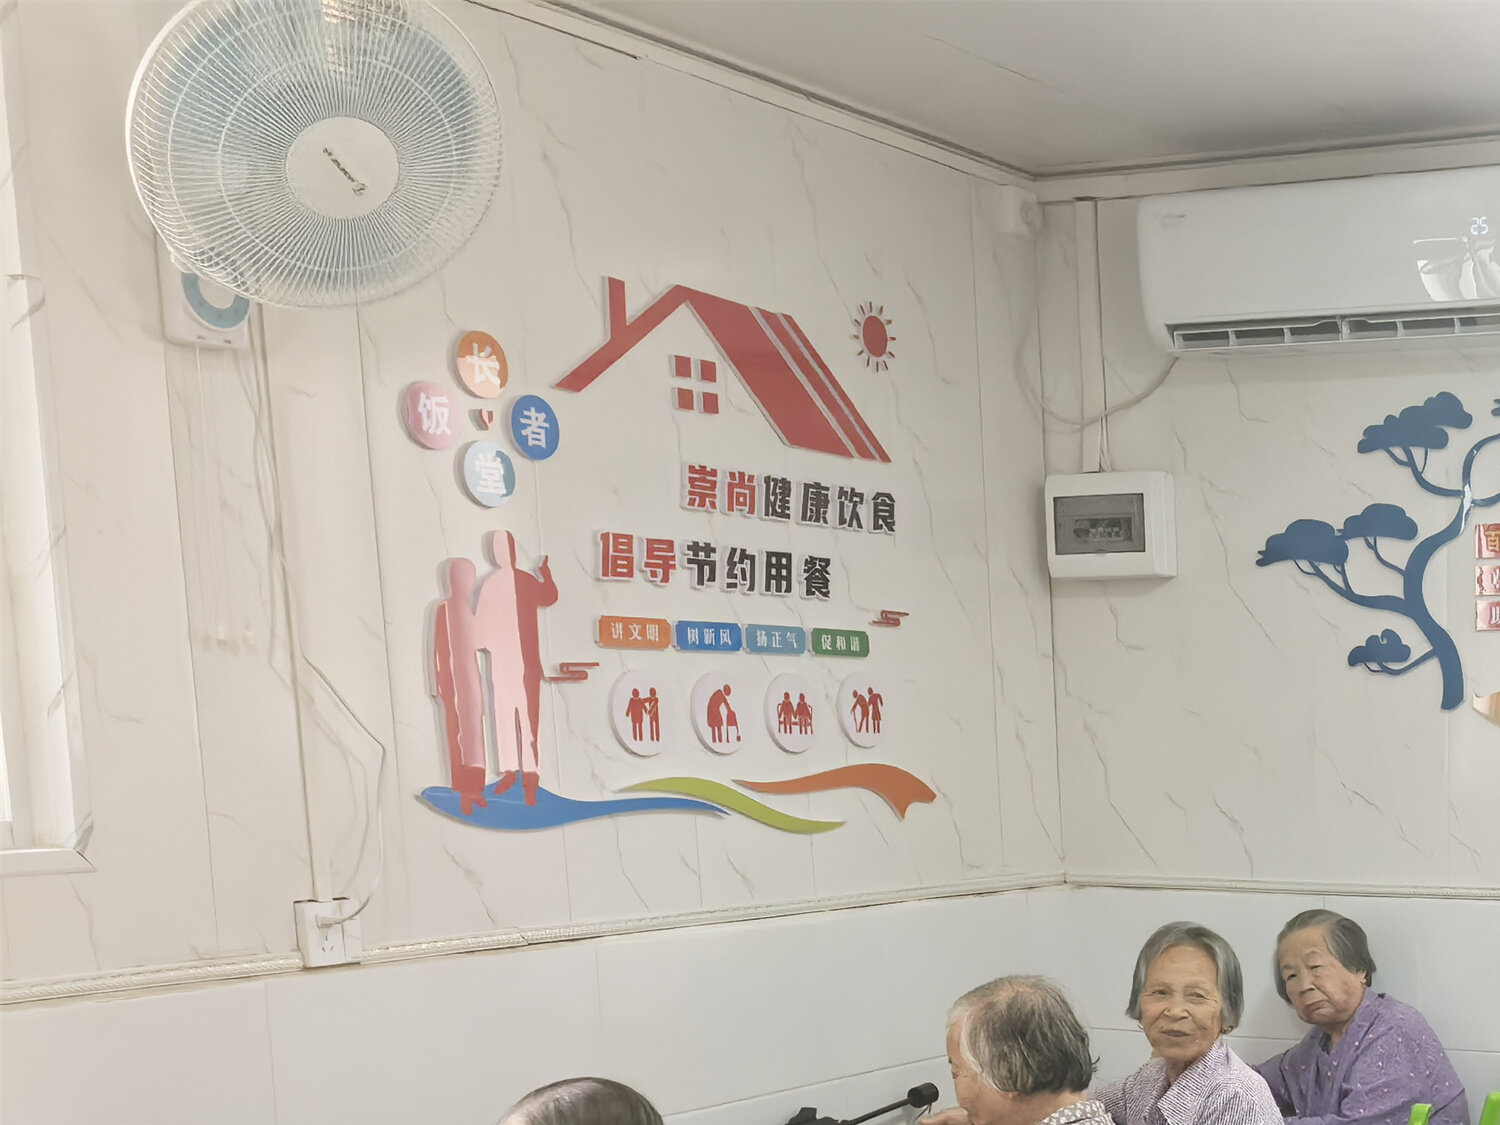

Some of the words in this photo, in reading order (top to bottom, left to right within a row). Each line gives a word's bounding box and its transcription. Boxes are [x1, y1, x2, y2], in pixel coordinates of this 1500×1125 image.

[1470, 216, 1489, 235] 25
[465, 342, 502, 386] 长
[417, 392, 452, 436] 饭
[519, 406, 550, 448] 者
[475, 452, 507, 496] 堂
[687, 464, 896, 534] 崇尚健康饮食
[600, 531, 831, 599] 倡导节约用餐
[610, 622, 660, 642] 讲文明
[687, 627, 733, 646] 树新风
[756, 631, 798, 649] 扬正气
[821, 634, 860, 652] 促和谐
